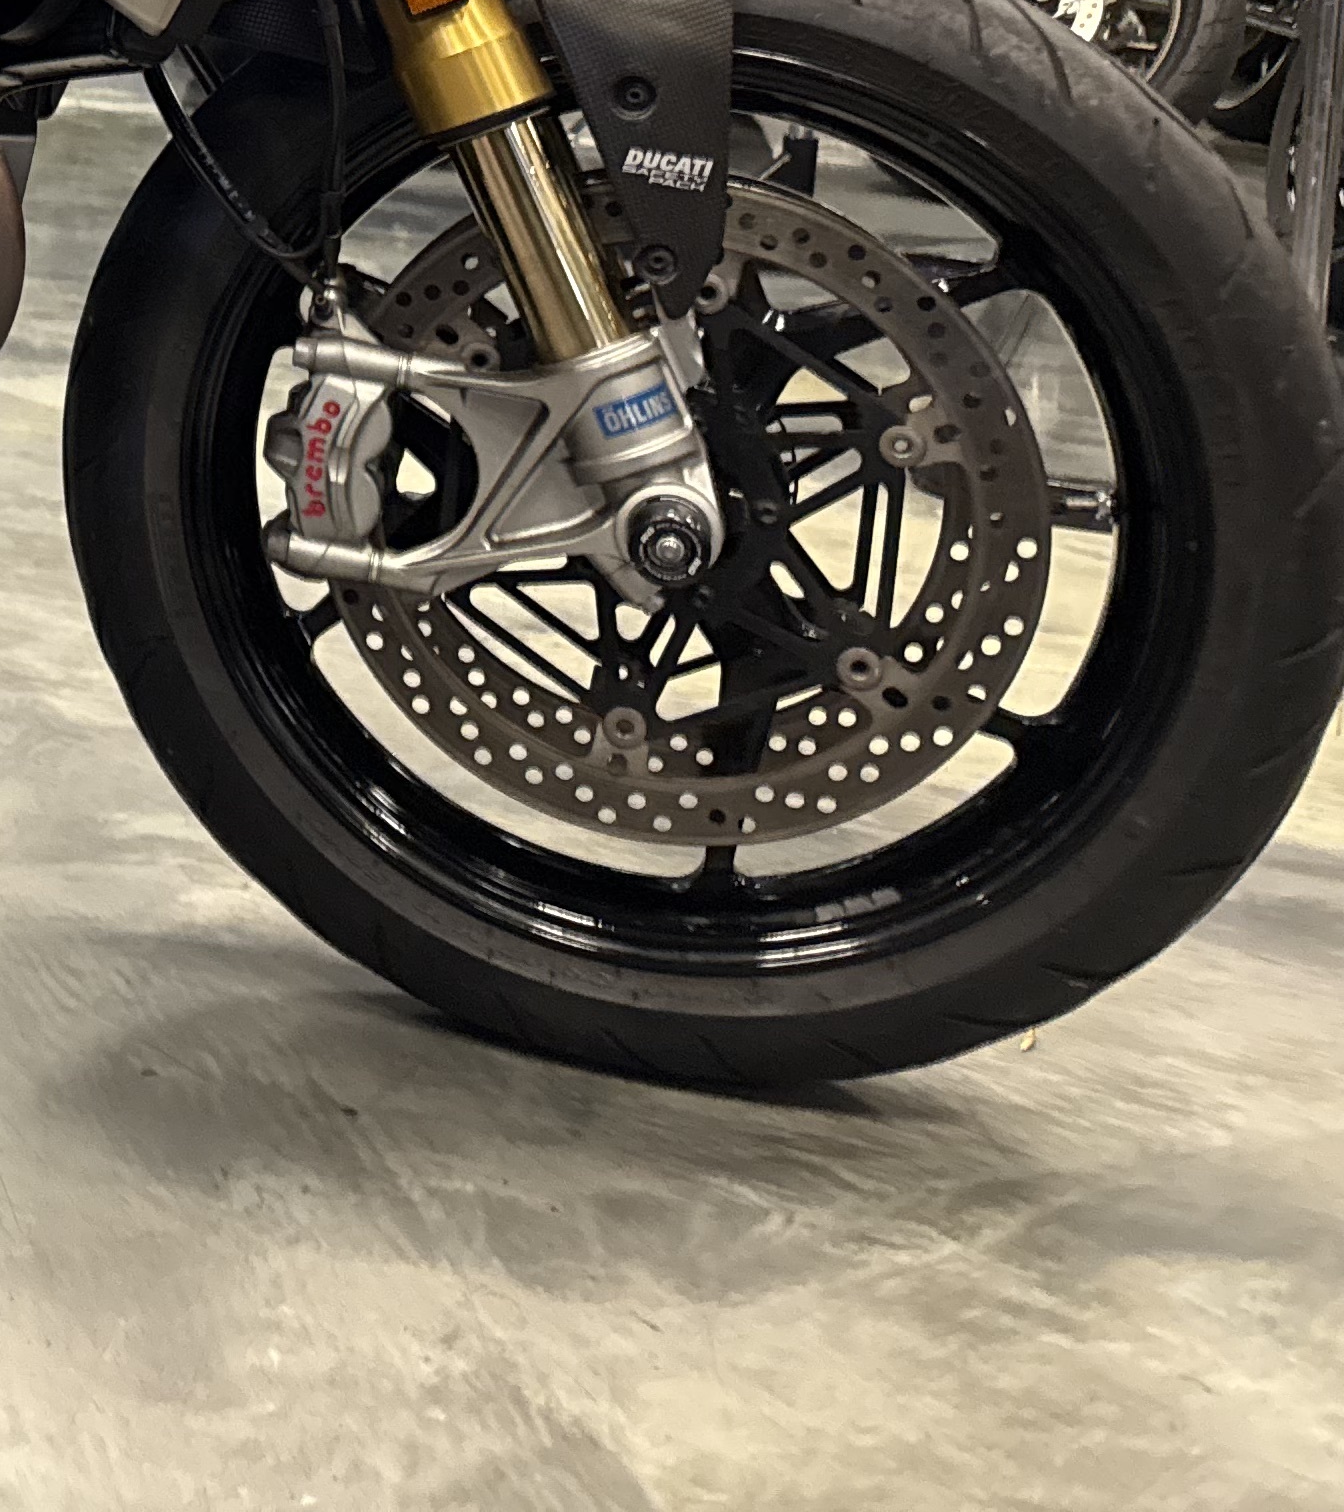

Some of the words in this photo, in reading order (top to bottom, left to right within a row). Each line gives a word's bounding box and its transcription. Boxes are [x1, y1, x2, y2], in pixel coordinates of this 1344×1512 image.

[623, 147, 714, 178] DUCATI
[601, 391, 673, 434] ÖHLINS
[302, 399, 341, 518] brembo
